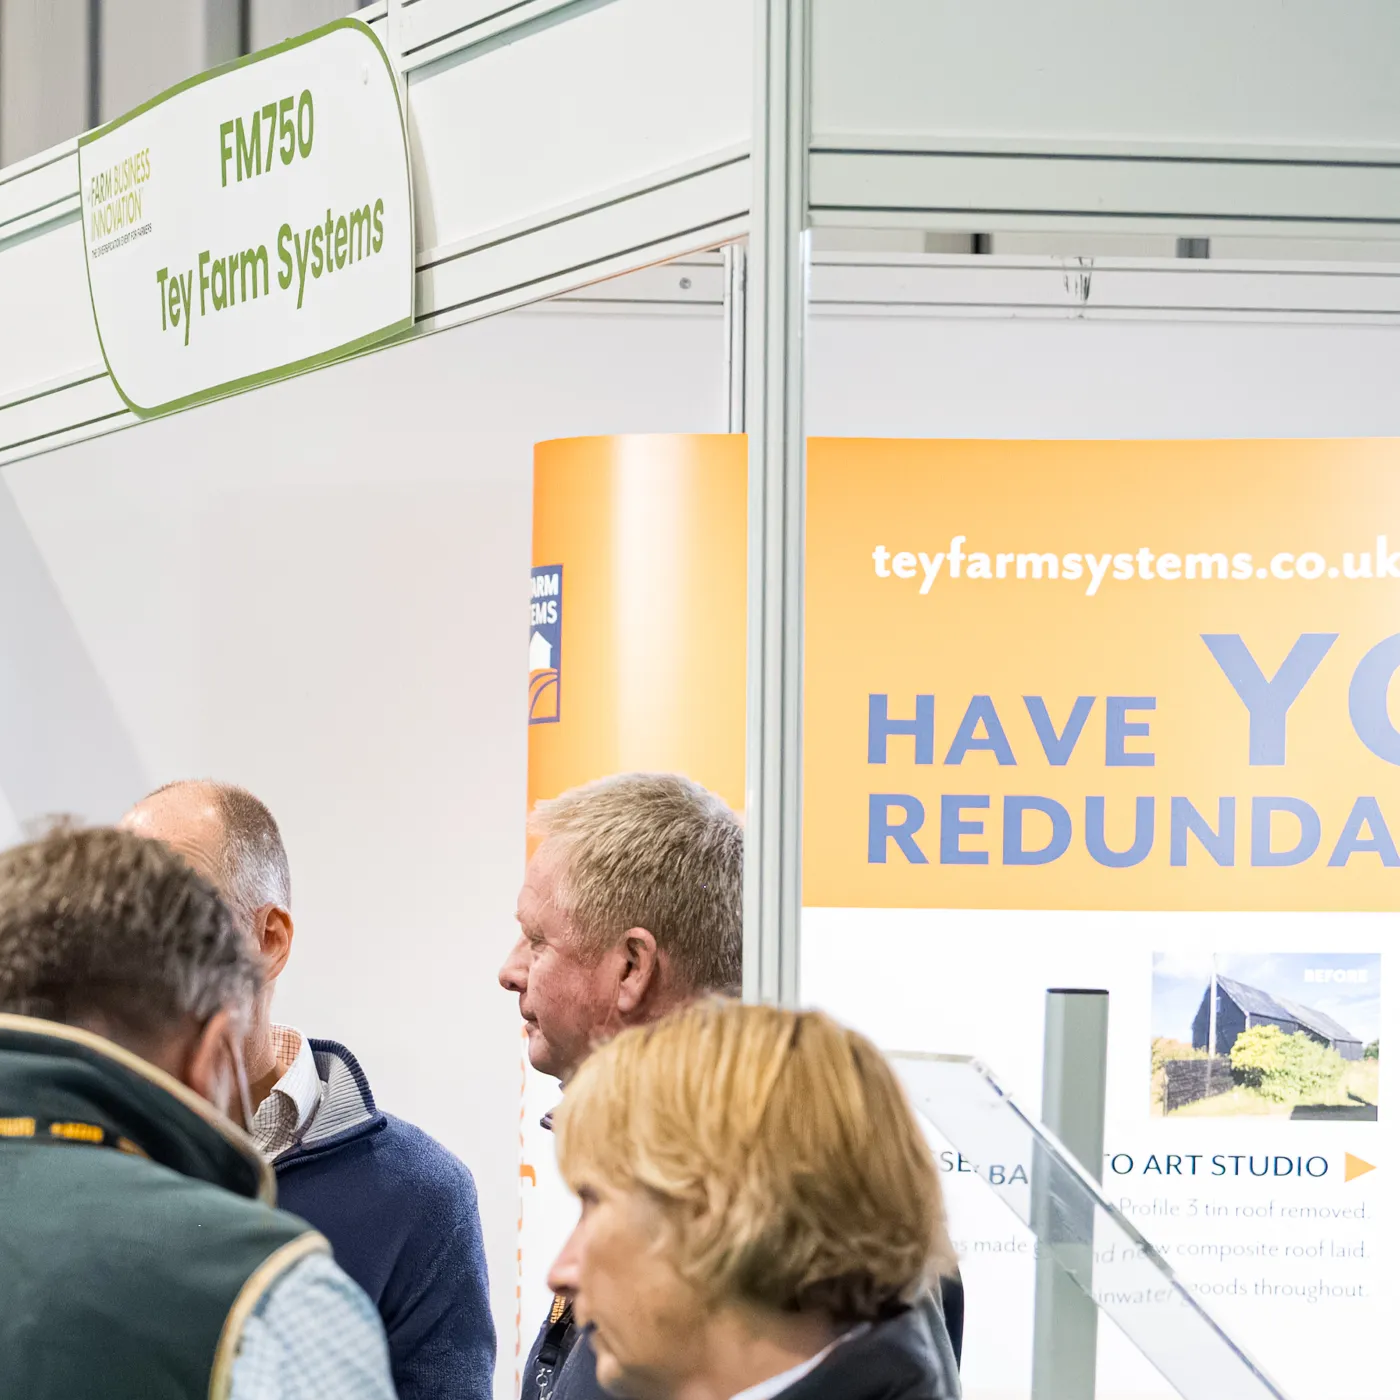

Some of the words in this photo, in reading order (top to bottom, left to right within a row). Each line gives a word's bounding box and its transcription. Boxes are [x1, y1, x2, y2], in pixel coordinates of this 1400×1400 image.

[219, 89, 314, 188] FM750
[156, 266, 193, 346] Tey
[198, 244, 269, 316] Farm
[277, 198, 384, 310] Systems
[531, 573, 559, 599] ARM
[873, 535, 1400, 595] teyfarmsystems.co.uk
[866, 694, 1157, 768] HAVE
[1143, 1154, 1203, 1177] ART
[1211, 1154, 1329, 1178] STUDIO
[1119, 1197, 1180, 1217] Profile
[1205, 1202, 1228, 1217] tin
[1235, 1200, 1276, 1217] roof
[1176, 1241, 1279, 1262] composite
[1285, 1240, 1326, 1258] roof
